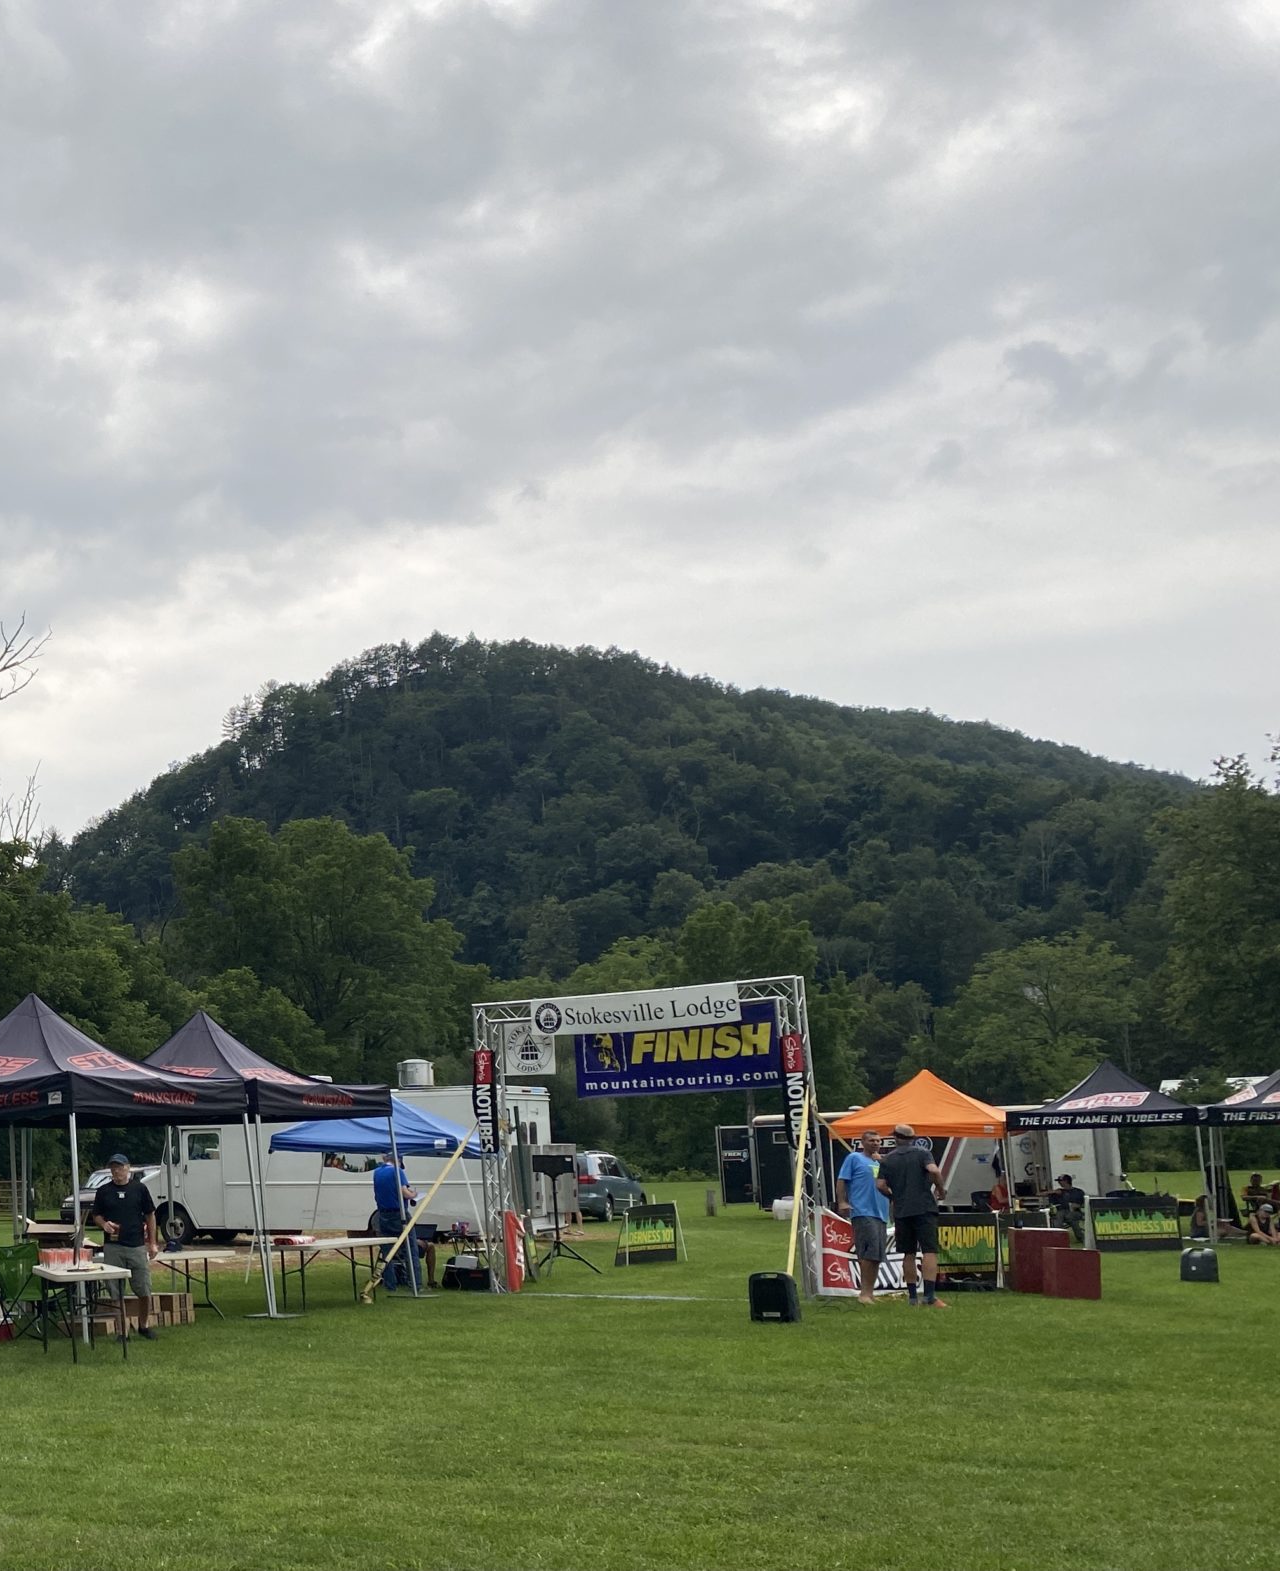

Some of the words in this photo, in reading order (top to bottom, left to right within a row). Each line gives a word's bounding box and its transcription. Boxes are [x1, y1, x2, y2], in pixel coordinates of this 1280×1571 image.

[565, 1001, 665, 1026] Stokesville
[670, 995, 737, 1018] Lodge
[631, 1021, 772, 1064] FINISH
[584, 1070, 779, 1091] mountaintouring.com
[476, 1083, 494, 1154] NOTUBES
[1020, 1116, 1040, 1126] THE
[1042, 1115, 1073, 1125] FIRST
[1076, 1114, 1108, 1124] NAME
[1111, 1114, 1122, 1123] IN
[1125, 1112, 1183, 1123] TUBELESS
[1223, 1112, 1247, 1121] THE
[662, 1227, 675, 1243] 101
[1095, 1220, 1161, 1234] WILDERNESS
[1162, 1219, 1179, 1233] 101
